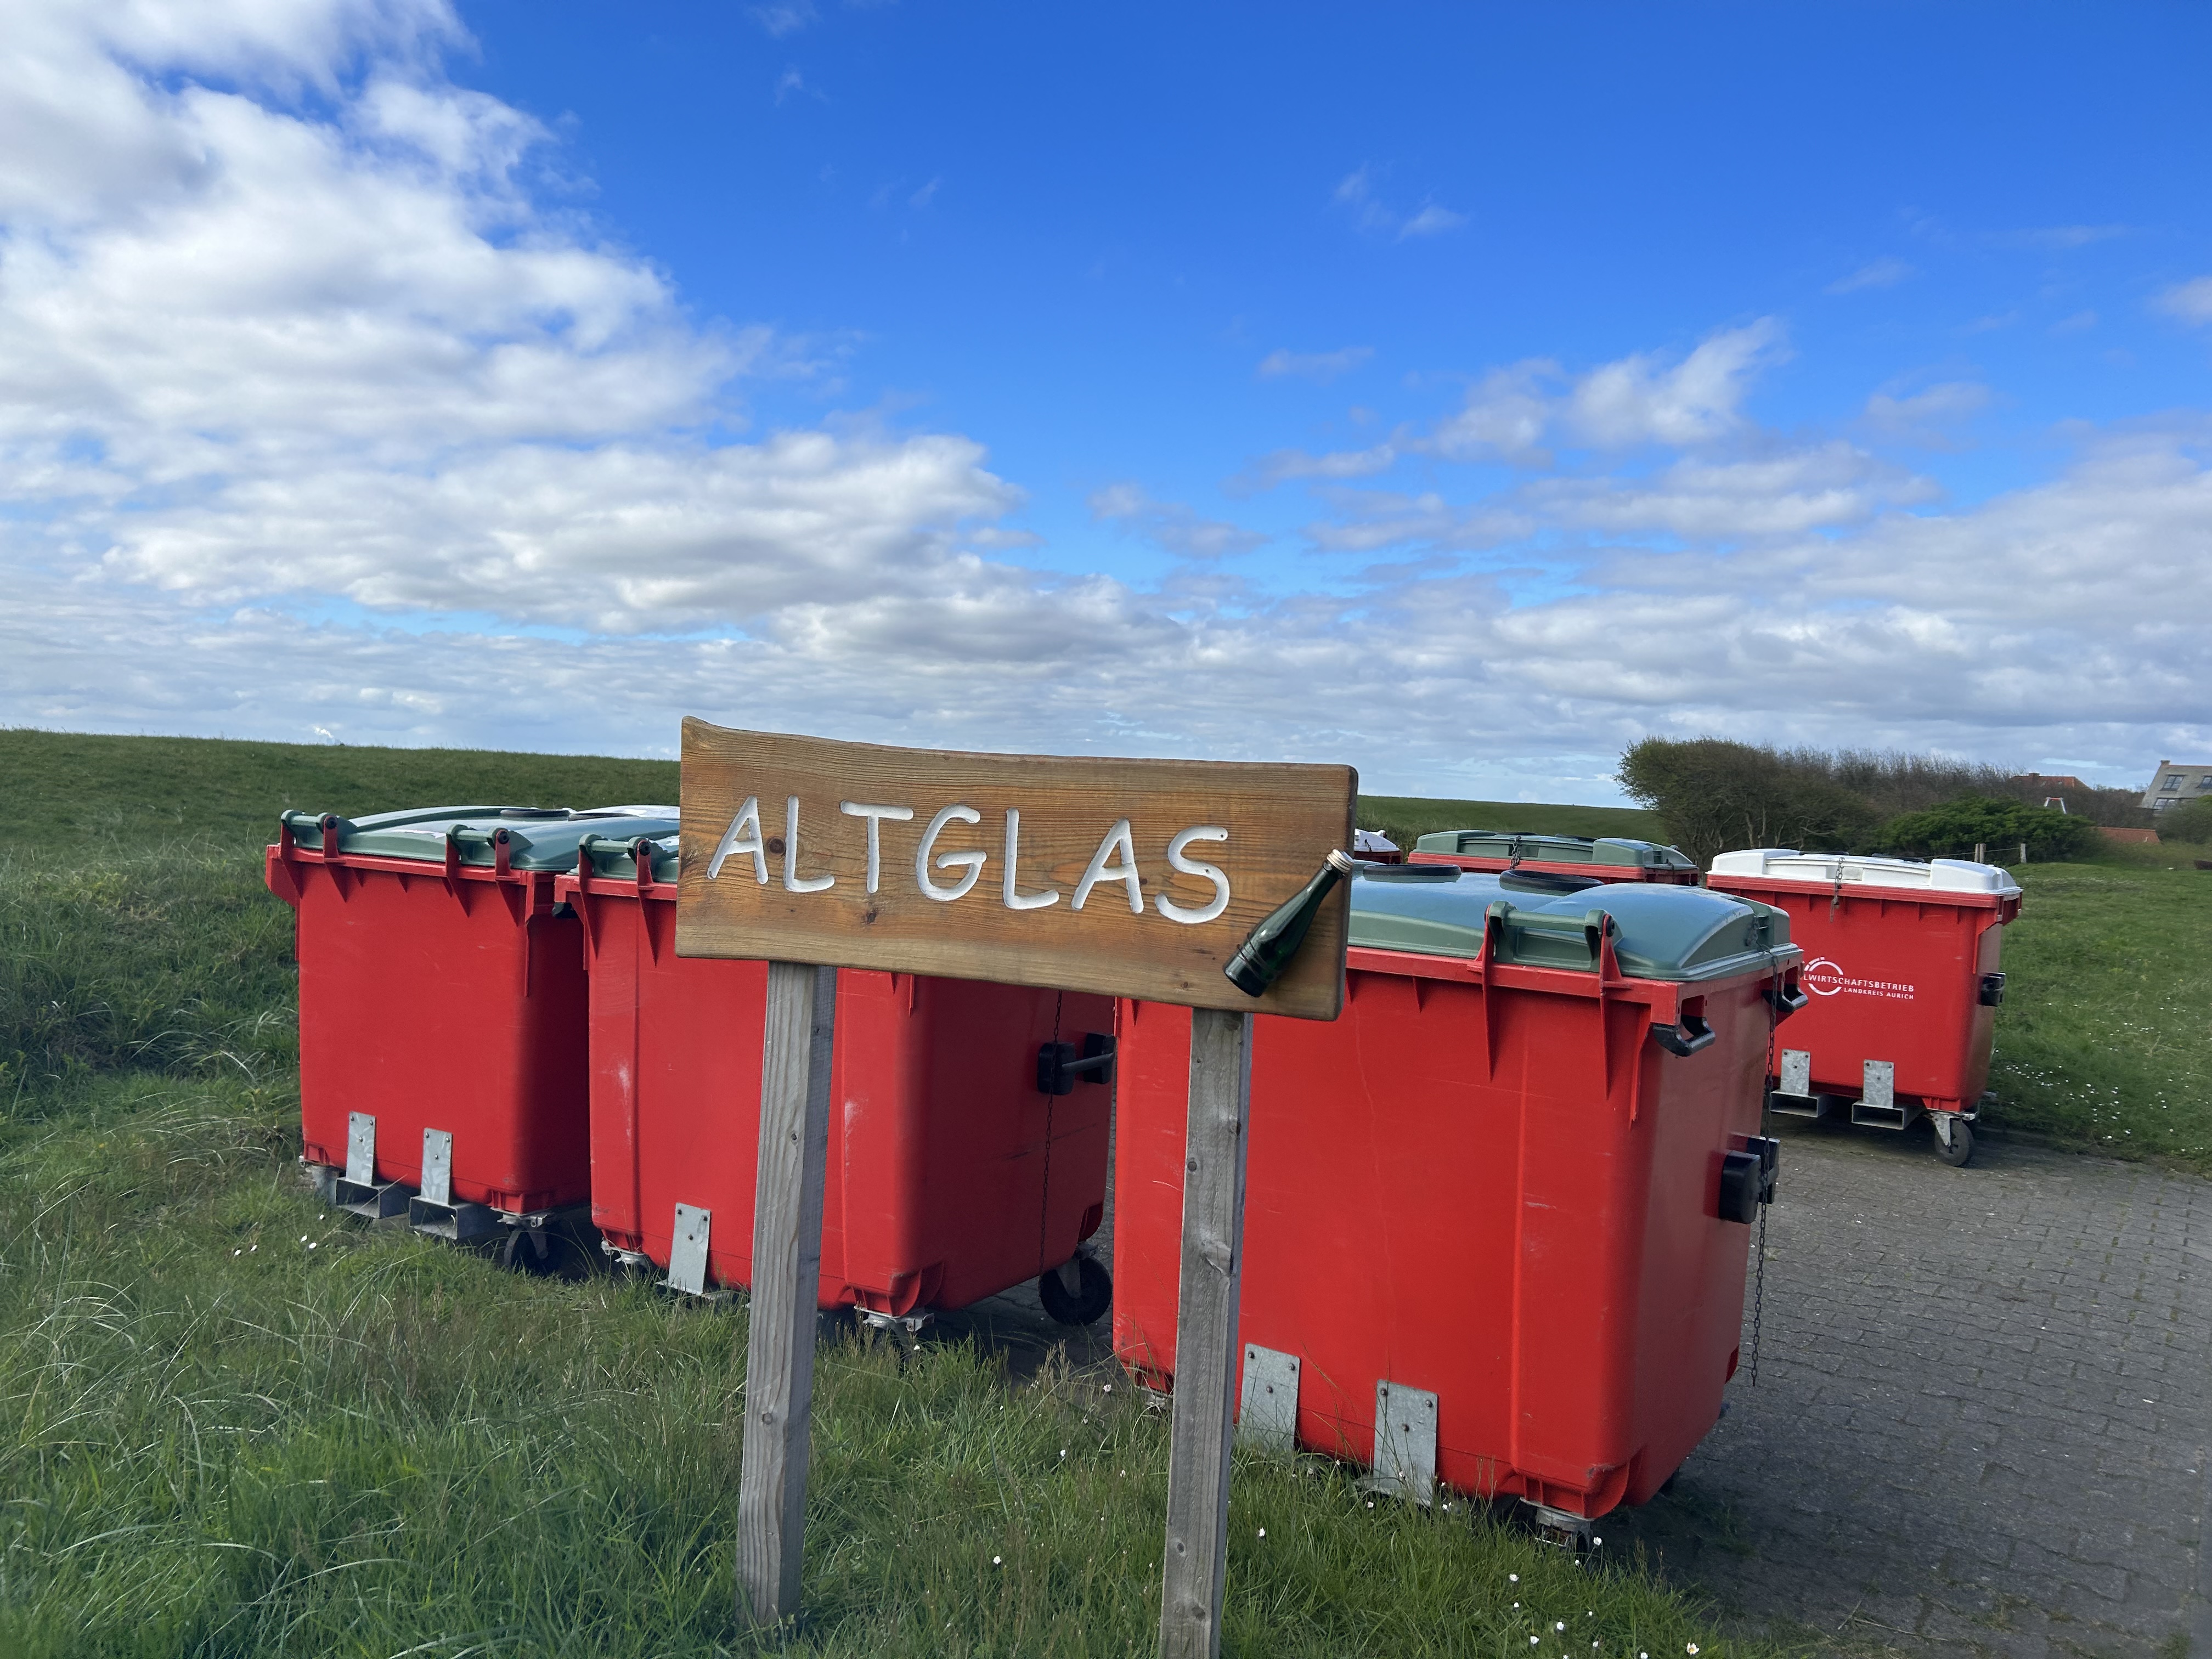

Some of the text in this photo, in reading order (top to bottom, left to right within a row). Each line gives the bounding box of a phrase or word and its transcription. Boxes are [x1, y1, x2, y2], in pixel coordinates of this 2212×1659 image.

[706, 794, 1231, 925] ALTGLAS
[1800, 974, 1914, 992] LWIRTSCHAFTSBETRIEB
[1843, 987, 1883, 996] LANDKREIS
